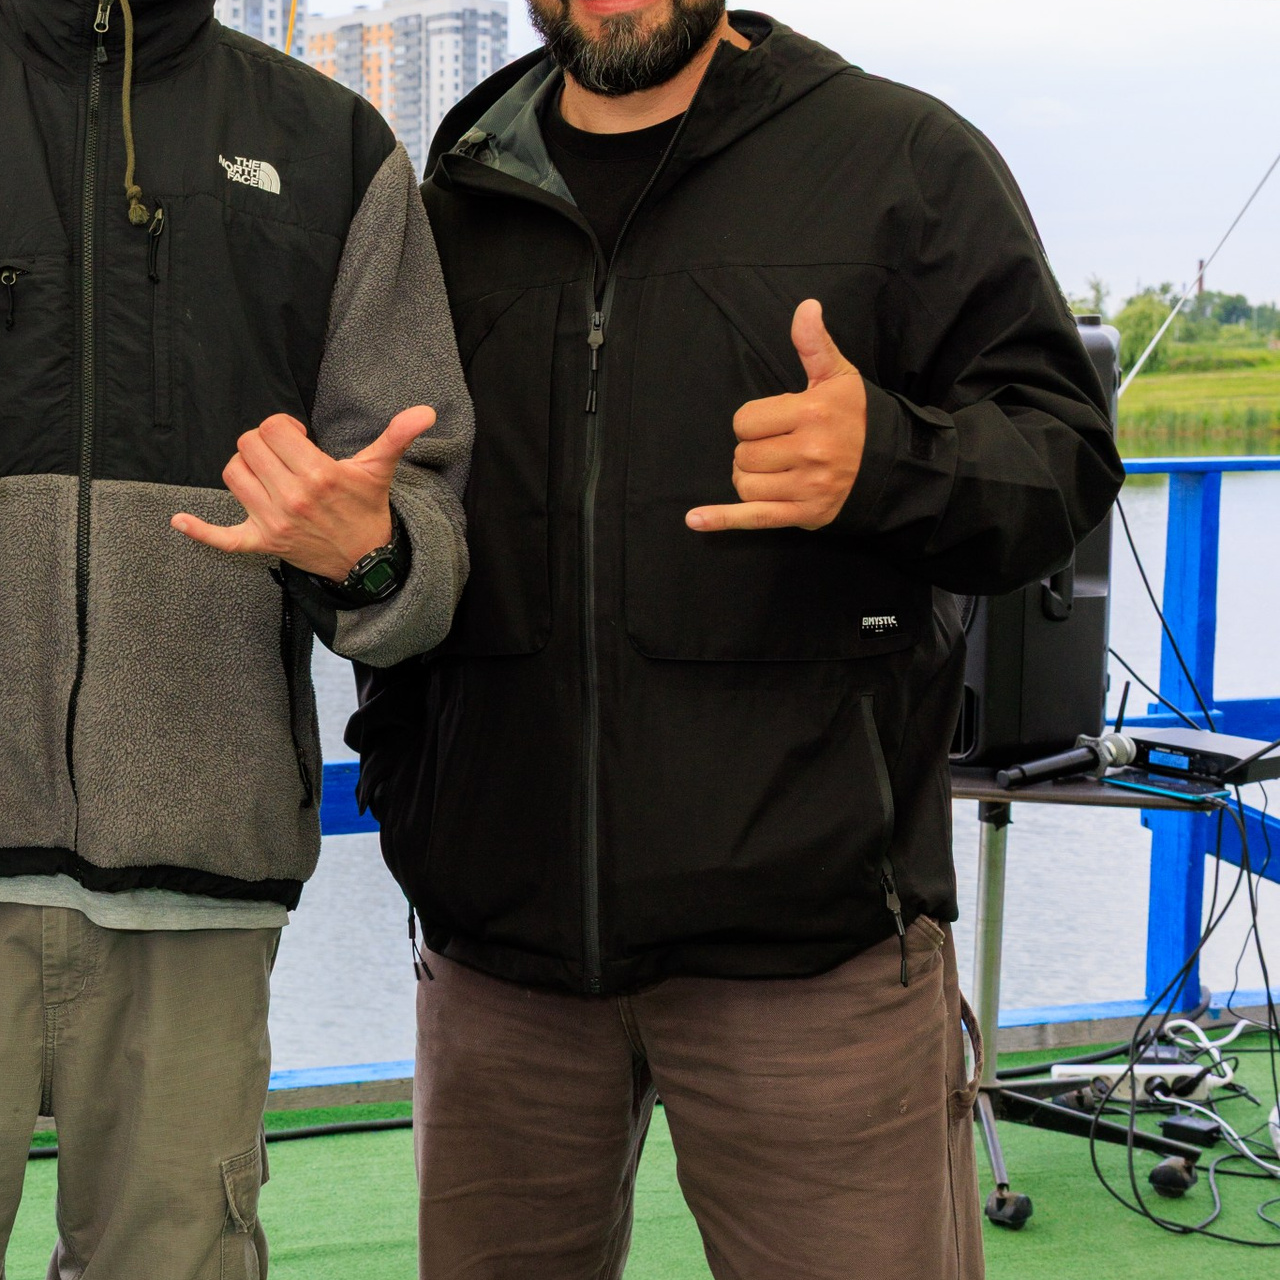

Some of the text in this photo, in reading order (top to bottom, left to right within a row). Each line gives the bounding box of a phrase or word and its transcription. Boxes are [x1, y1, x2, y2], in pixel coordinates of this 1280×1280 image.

[219, 154, 260, 178] NORTH
[235, 156, 261, 170] THE
[227, 171, 260, 187] FACE
[868, 615, 897, 626] MYSTIC
